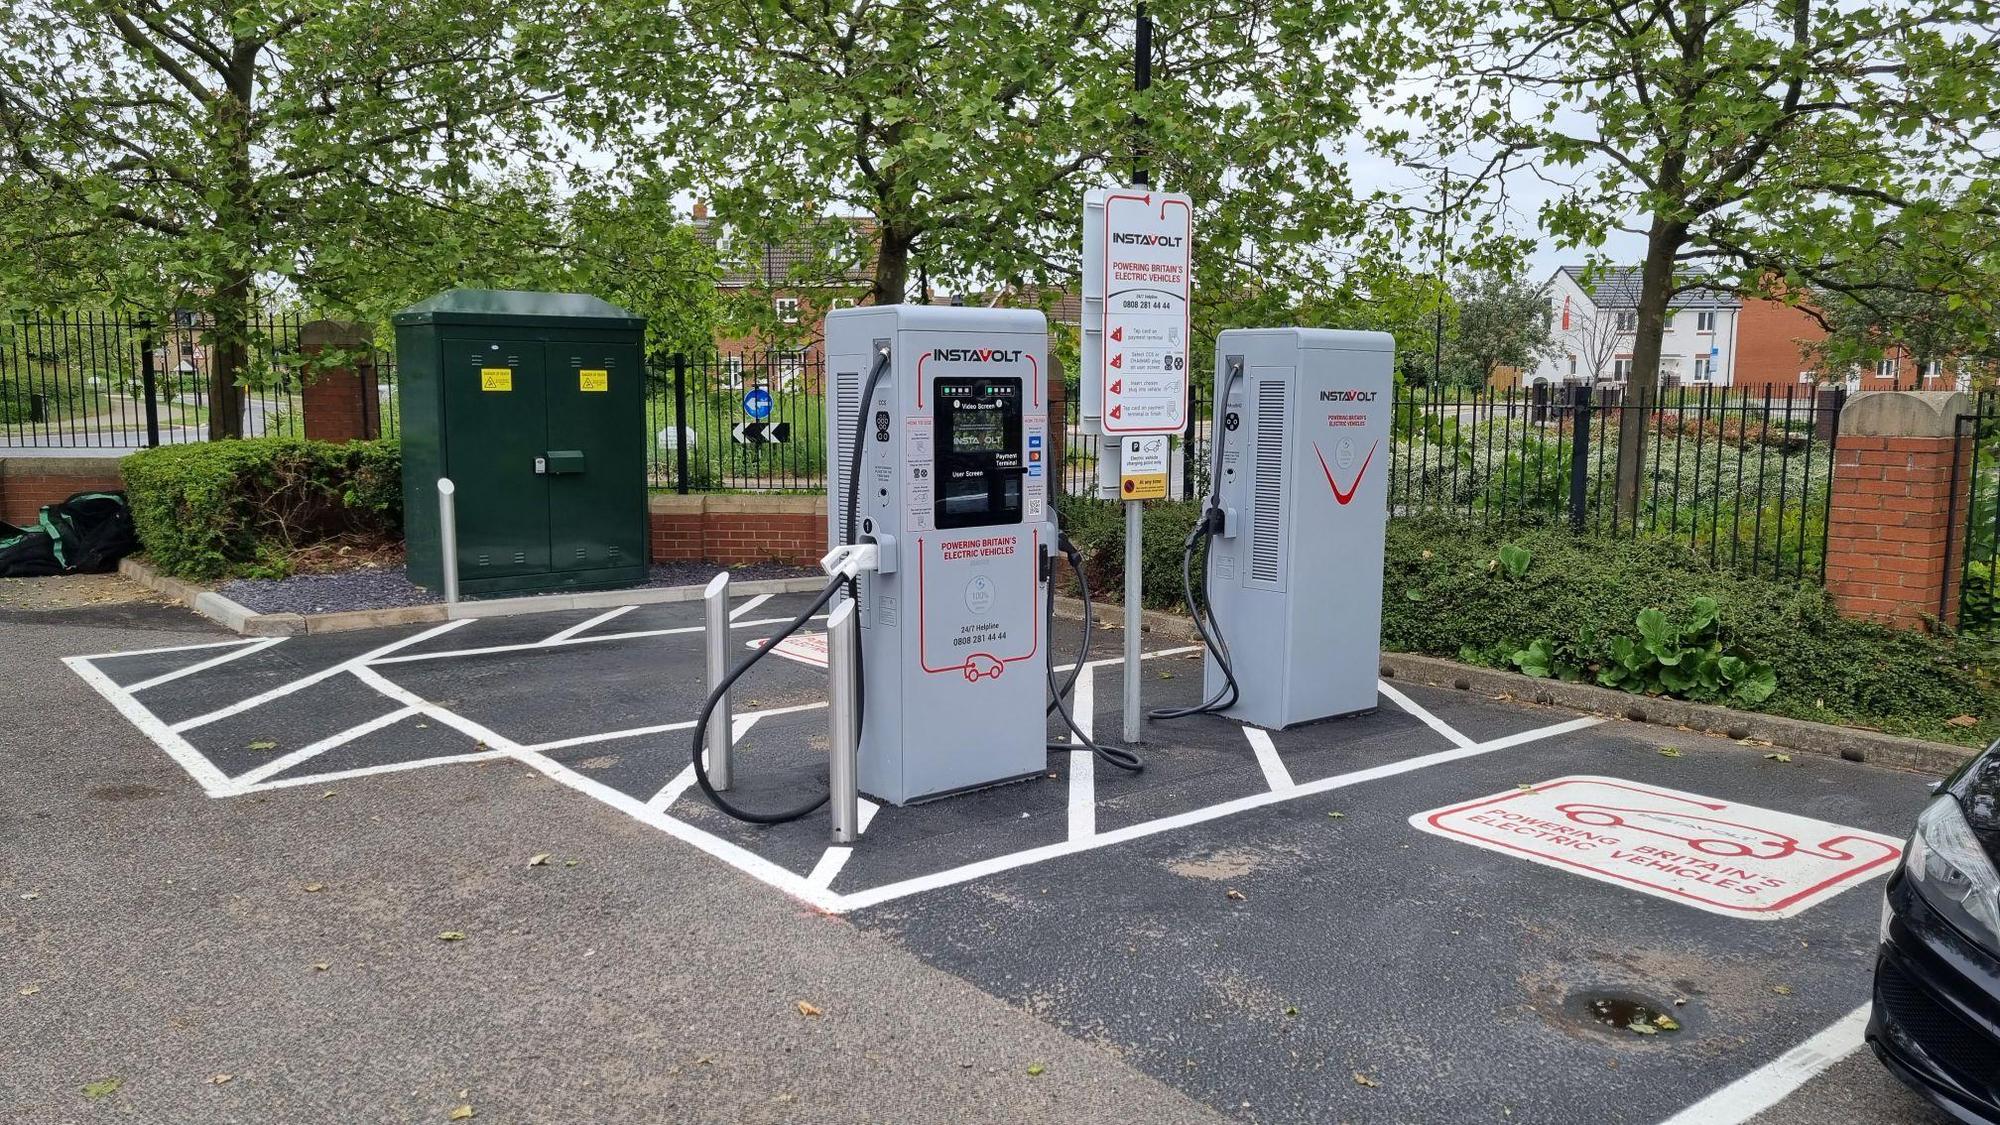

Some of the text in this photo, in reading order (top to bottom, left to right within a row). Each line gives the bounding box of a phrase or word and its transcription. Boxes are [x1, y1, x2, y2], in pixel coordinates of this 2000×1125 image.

[1113, 232, 1183, 247] INSTAVOLT
[1112, 262, 1183, 273] POWERING BRITAIN'S
[1115, 272, 1181, 283] ELECTRIC VEHICLES
[1140, 301, 1151, 309] 281
[933, 348, 1022, 362] INSTAVOLT
[1320, 390, 1377, 401] INSTAVOLT
[953, 436, 1001, 445] INSTAOLT
[941, 536, 1017, 551] POWERING BRITAIN'S
[944, 546, 1014, 560] ELECTRIC VEHICLES
[961, 622, 1000, 634] 24/7 Helpline
[953, 632, 1007, 646] 0808 281 44 44
[1465, 814, 1764, 895] ELECTRIC VEHICLES
[1484, 808, 1787, 889] POWERING BRITAIN'S
